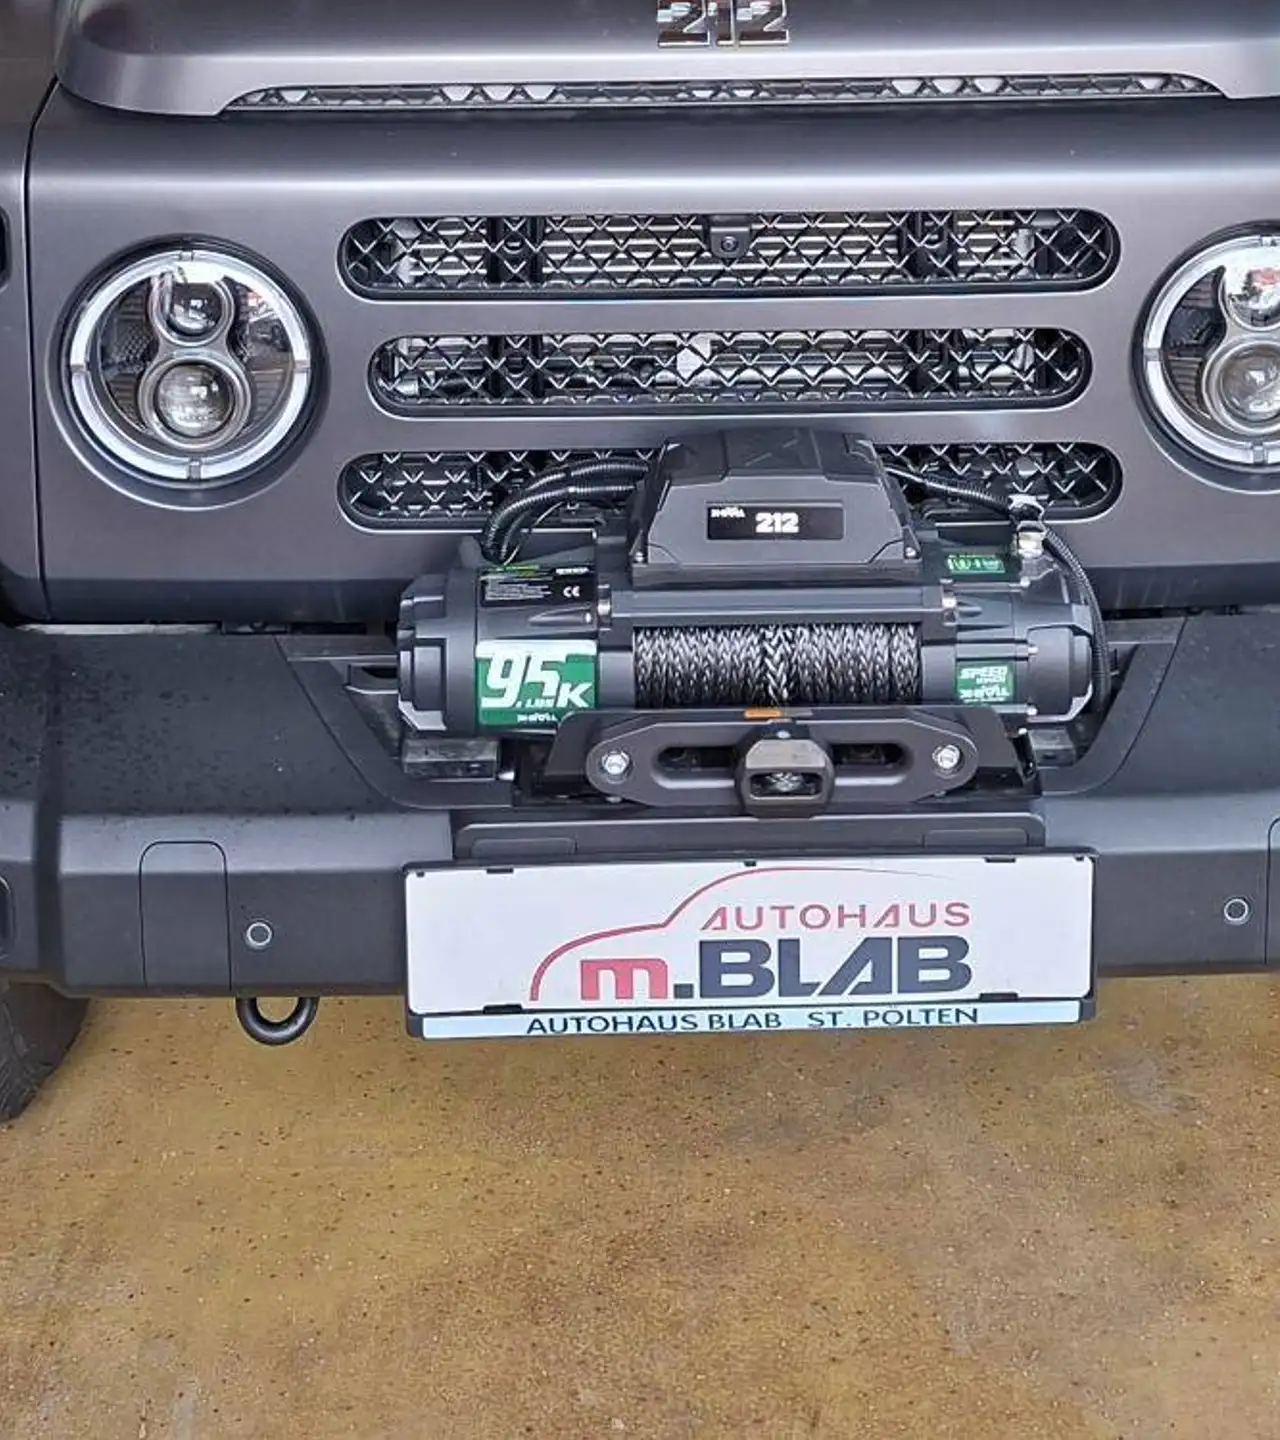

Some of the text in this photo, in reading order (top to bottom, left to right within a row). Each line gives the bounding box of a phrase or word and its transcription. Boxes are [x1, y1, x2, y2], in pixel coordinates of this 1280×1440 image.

[755, 512, 799, 533] 212
[701, 902, 971, 931] AUTOHAUS
[580, 935, 972, 1001] m.BLAB
[526, 1014, 698, 1034] AUTOHAUS
[709, 1012, 782, 1030] BLAB
[808, 1010, 852, 1028] ST.
